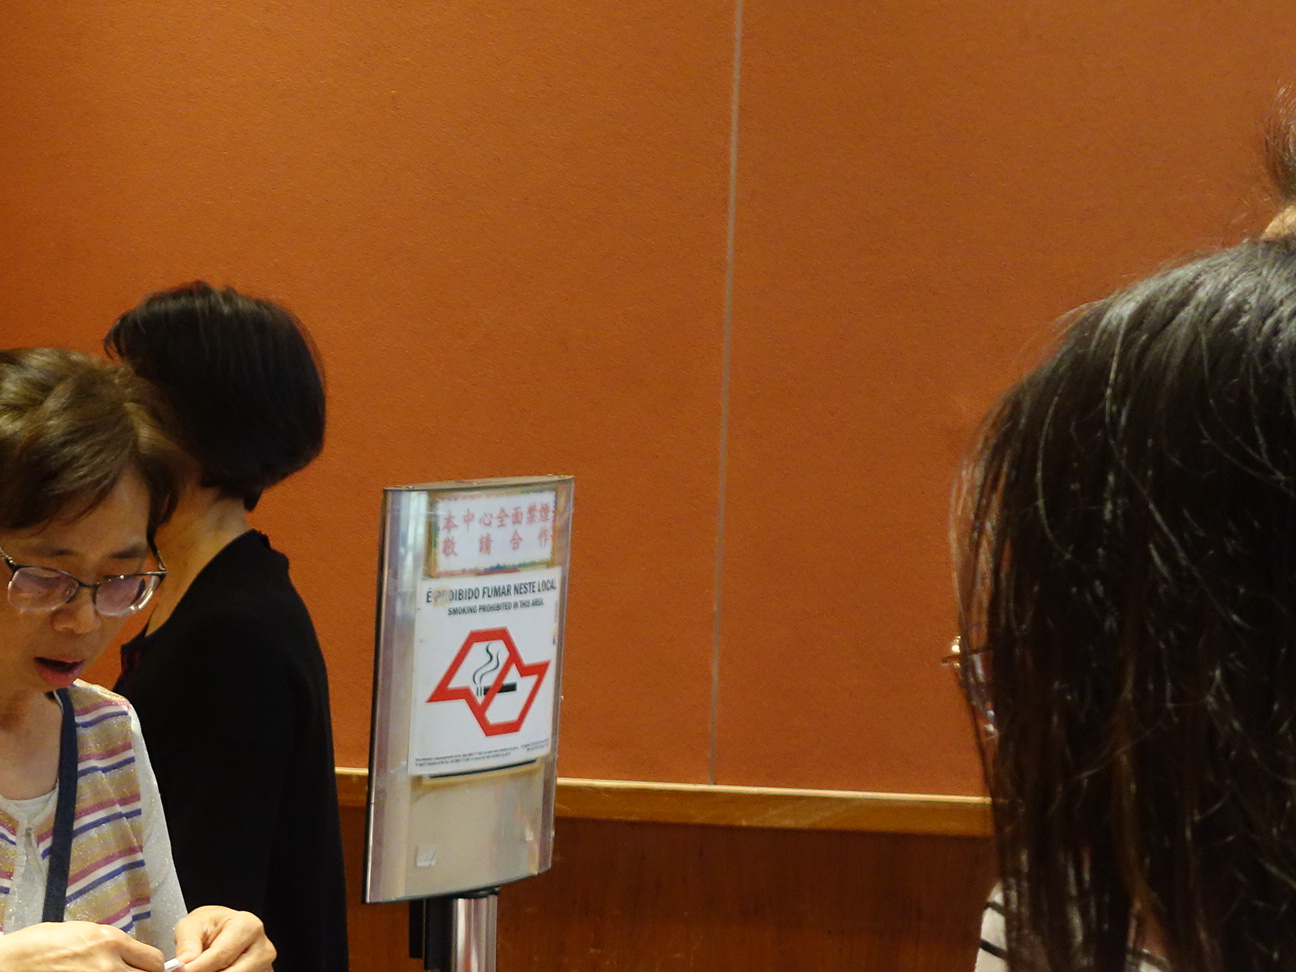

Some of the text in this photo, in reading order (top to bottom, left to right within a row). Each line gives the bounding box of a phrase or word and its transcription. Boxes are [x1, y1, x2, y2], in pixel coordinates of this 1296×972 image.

[426, 587, 433, 603] É
[482, 584, 512, 598] FUMAR
[514, 581, 536, 596] NESTE
[537, 578, 557, 592] LOCAL
[447, 604, 477, 616] SMOKING
[478, 601, 512, 613] PROHIBITED
[519, 599, 531, 609] THIS
[532, 597, 544, 607] AREA
